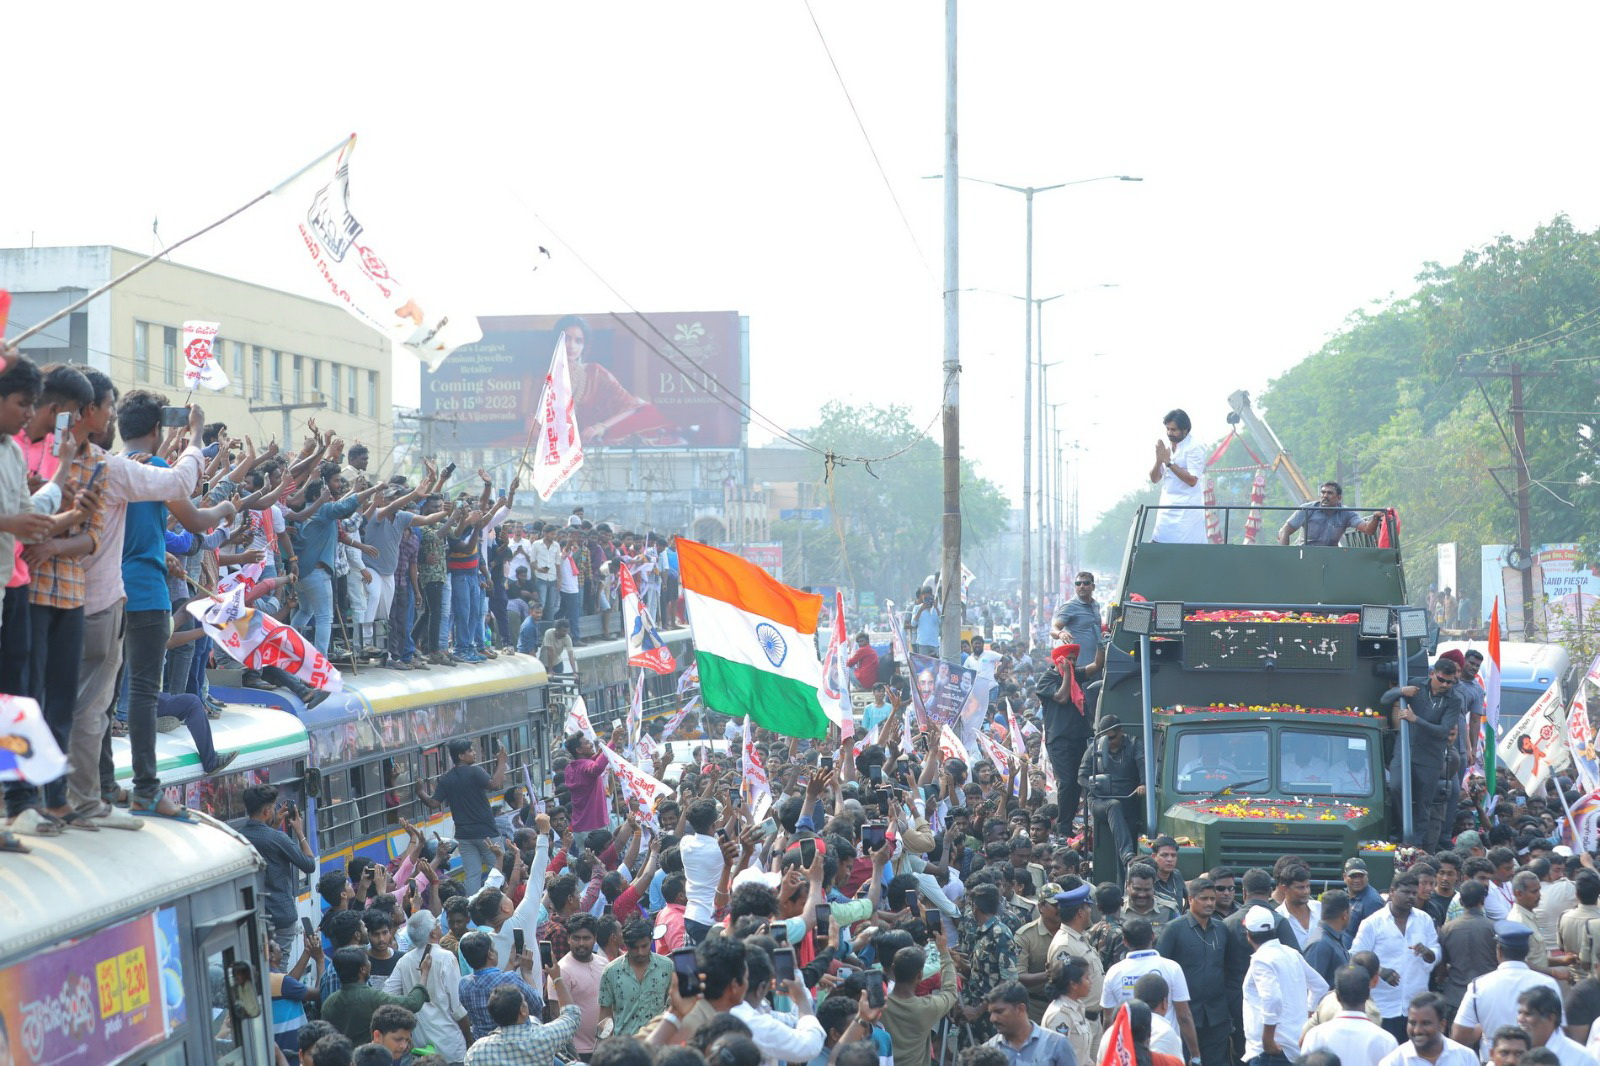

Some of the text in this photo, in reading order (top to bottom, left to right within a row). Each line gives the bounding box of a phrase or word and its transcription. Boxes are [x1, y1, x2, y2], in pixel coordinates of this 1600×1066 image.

[460, 364, 494, 374] Retailer
[430, 379, 521, 393] Coming Soon
[660, 372, 718, 393] BNR
[435, 395, 517, 410] Feb 15th 2023
[1563, 576, 1589, 586] FIESTA
